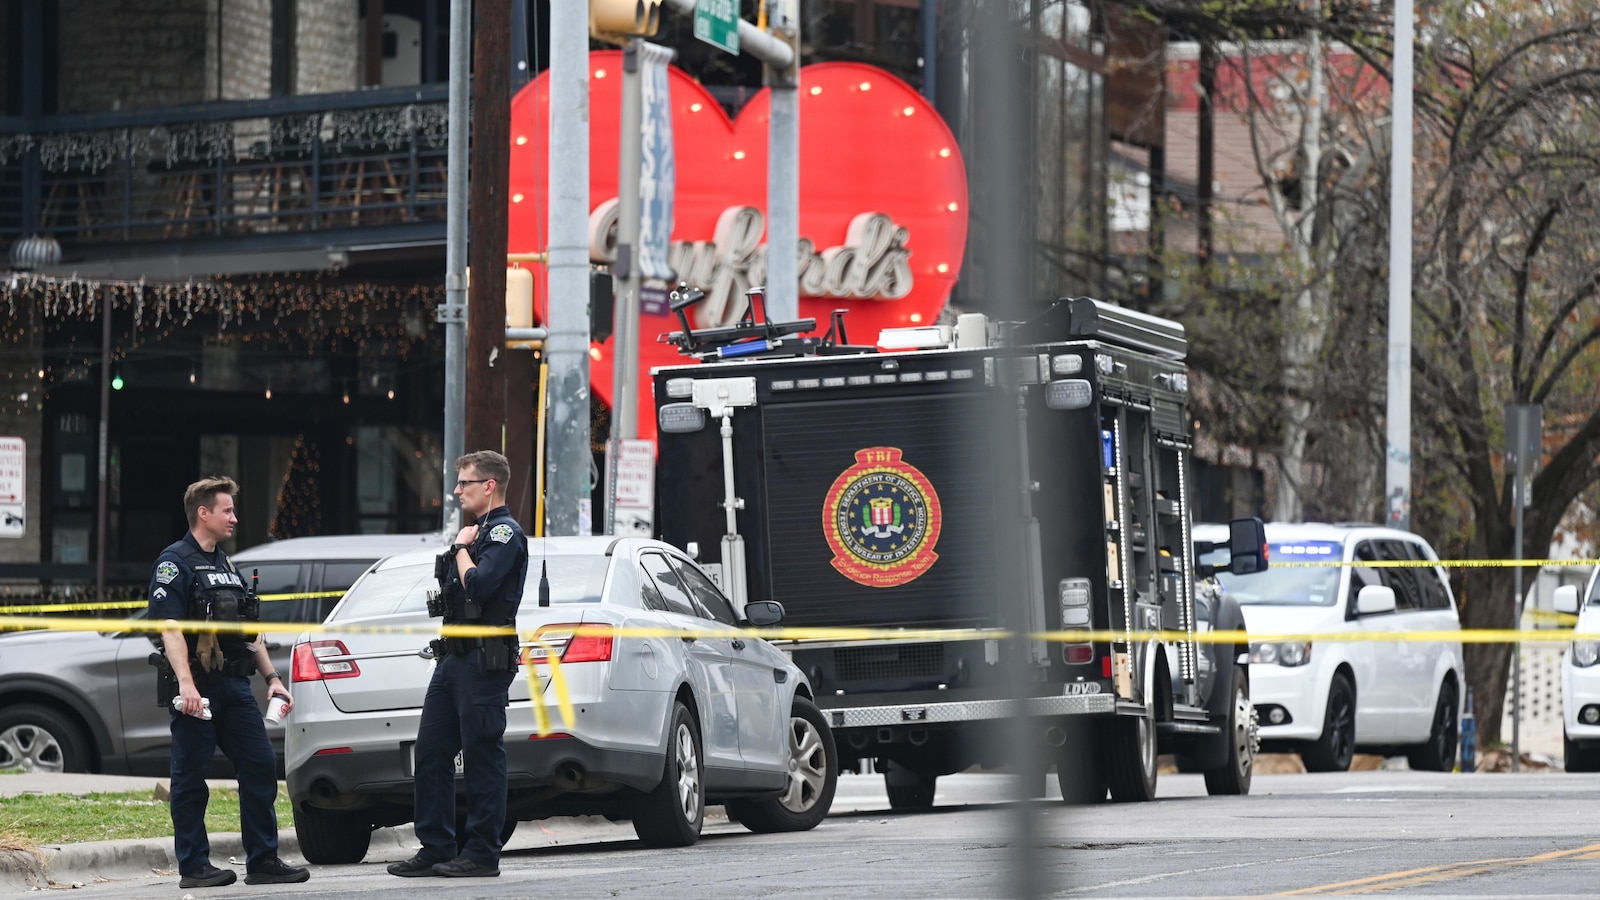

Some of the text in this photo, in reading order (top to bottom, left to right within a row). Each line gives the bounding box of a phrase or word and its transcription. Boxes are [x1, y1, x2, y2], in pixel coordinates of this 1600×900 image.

[866, 450, 892, 463] FBI
[842, 475, 883, 508] DEPARTMENT
[896, 479, 920, 503] JUSTICE
[840, 507, 924, 561] FEDERAL BUREAU OF INVESTIGATION
[838, 554, 931, 583] Evidence Response Team
[207, 573, 243, 588] POLIC
[1063, 682, 1090, 695] LDV
